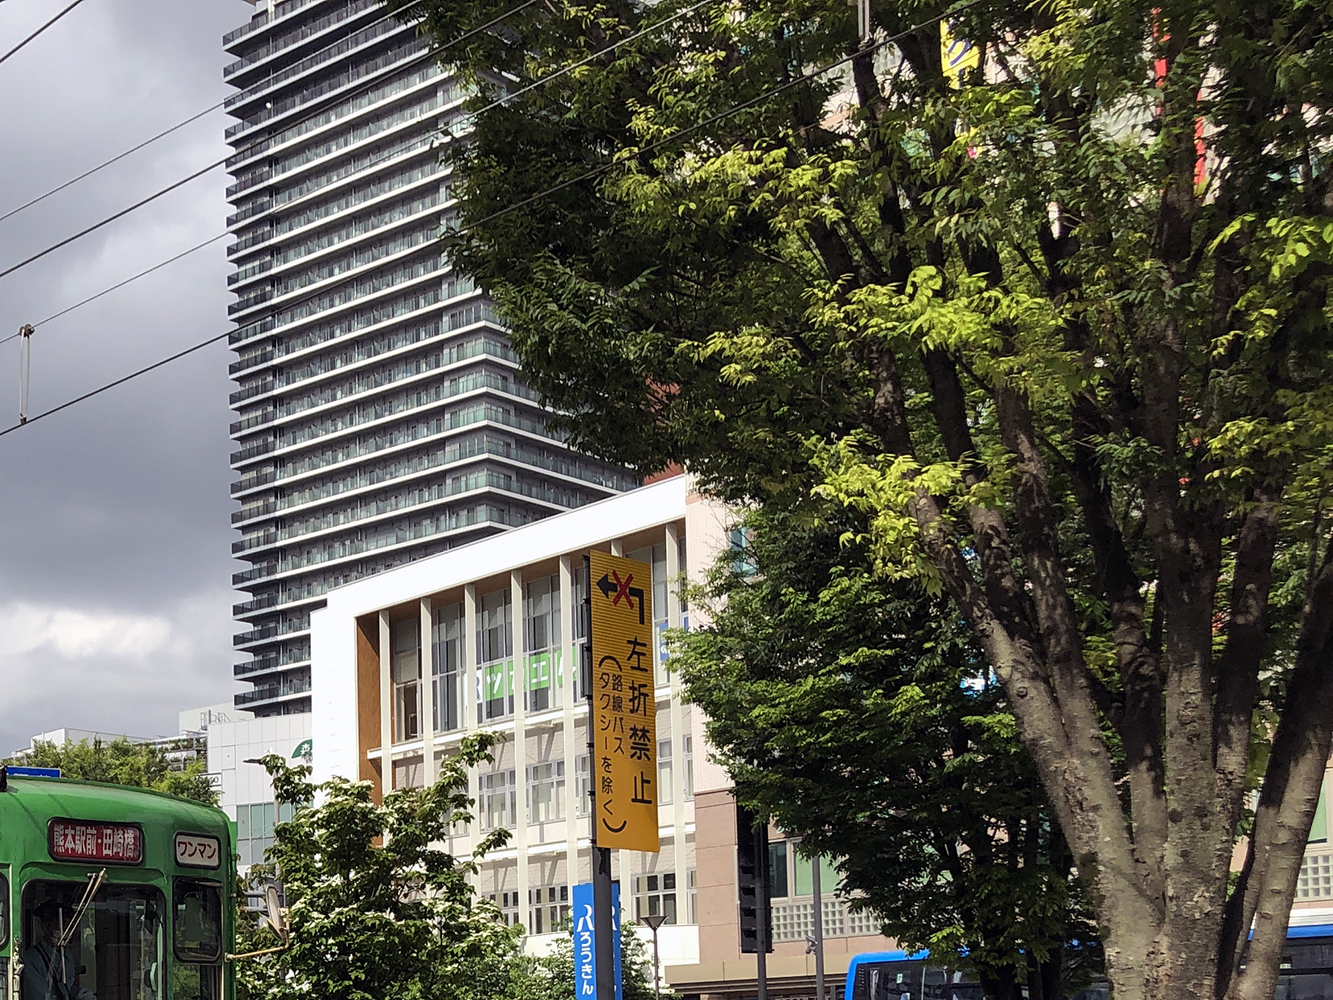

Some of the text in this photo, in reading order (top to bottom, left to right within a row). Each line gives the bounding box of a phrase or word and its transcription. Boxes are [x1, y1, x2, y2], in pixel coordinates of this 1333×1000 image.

[626, 635, 653, 805] 左折禁止
[177, 841, 216, 860] ワンマン
[579, 931, 594, 996] ろうきん
